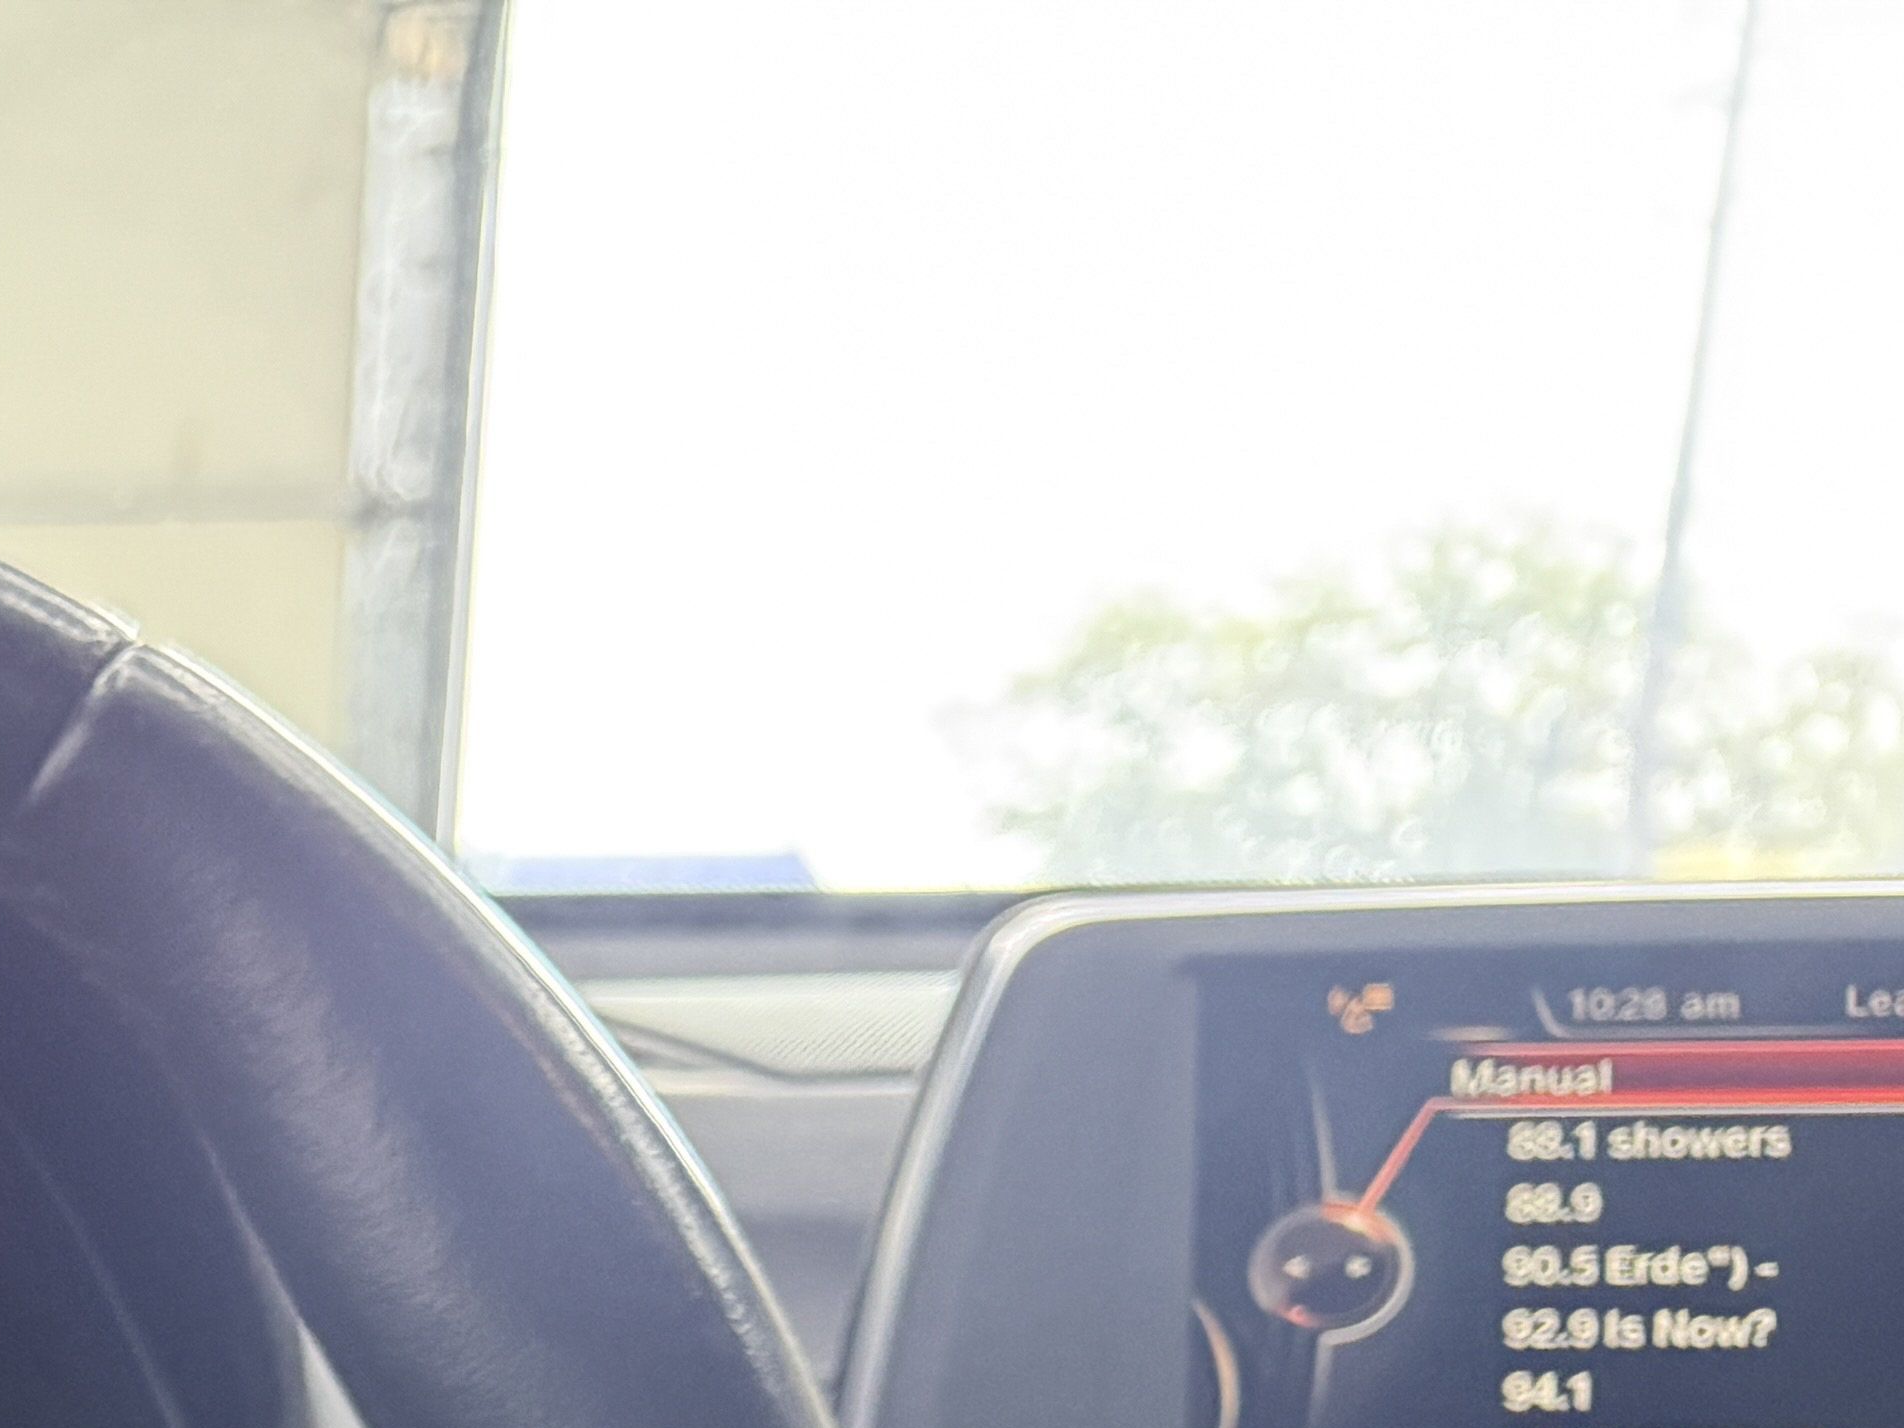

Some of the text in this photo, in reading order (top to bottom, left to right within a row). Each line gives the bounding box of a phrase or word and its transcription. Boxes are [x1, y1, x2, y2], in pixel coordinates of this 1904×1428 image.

[1680, 991, 1741, 1019] am
[1450, 1057, 1613, 1097] Manual
[1607, 1121, 1792, 1160] showers
[1502, 1244, 1600, 1287] 90.5
[1502, 1307, 1777, 1349] 92.9 Is Now?
[1501, 1370, 1592, 1413] 94.1
